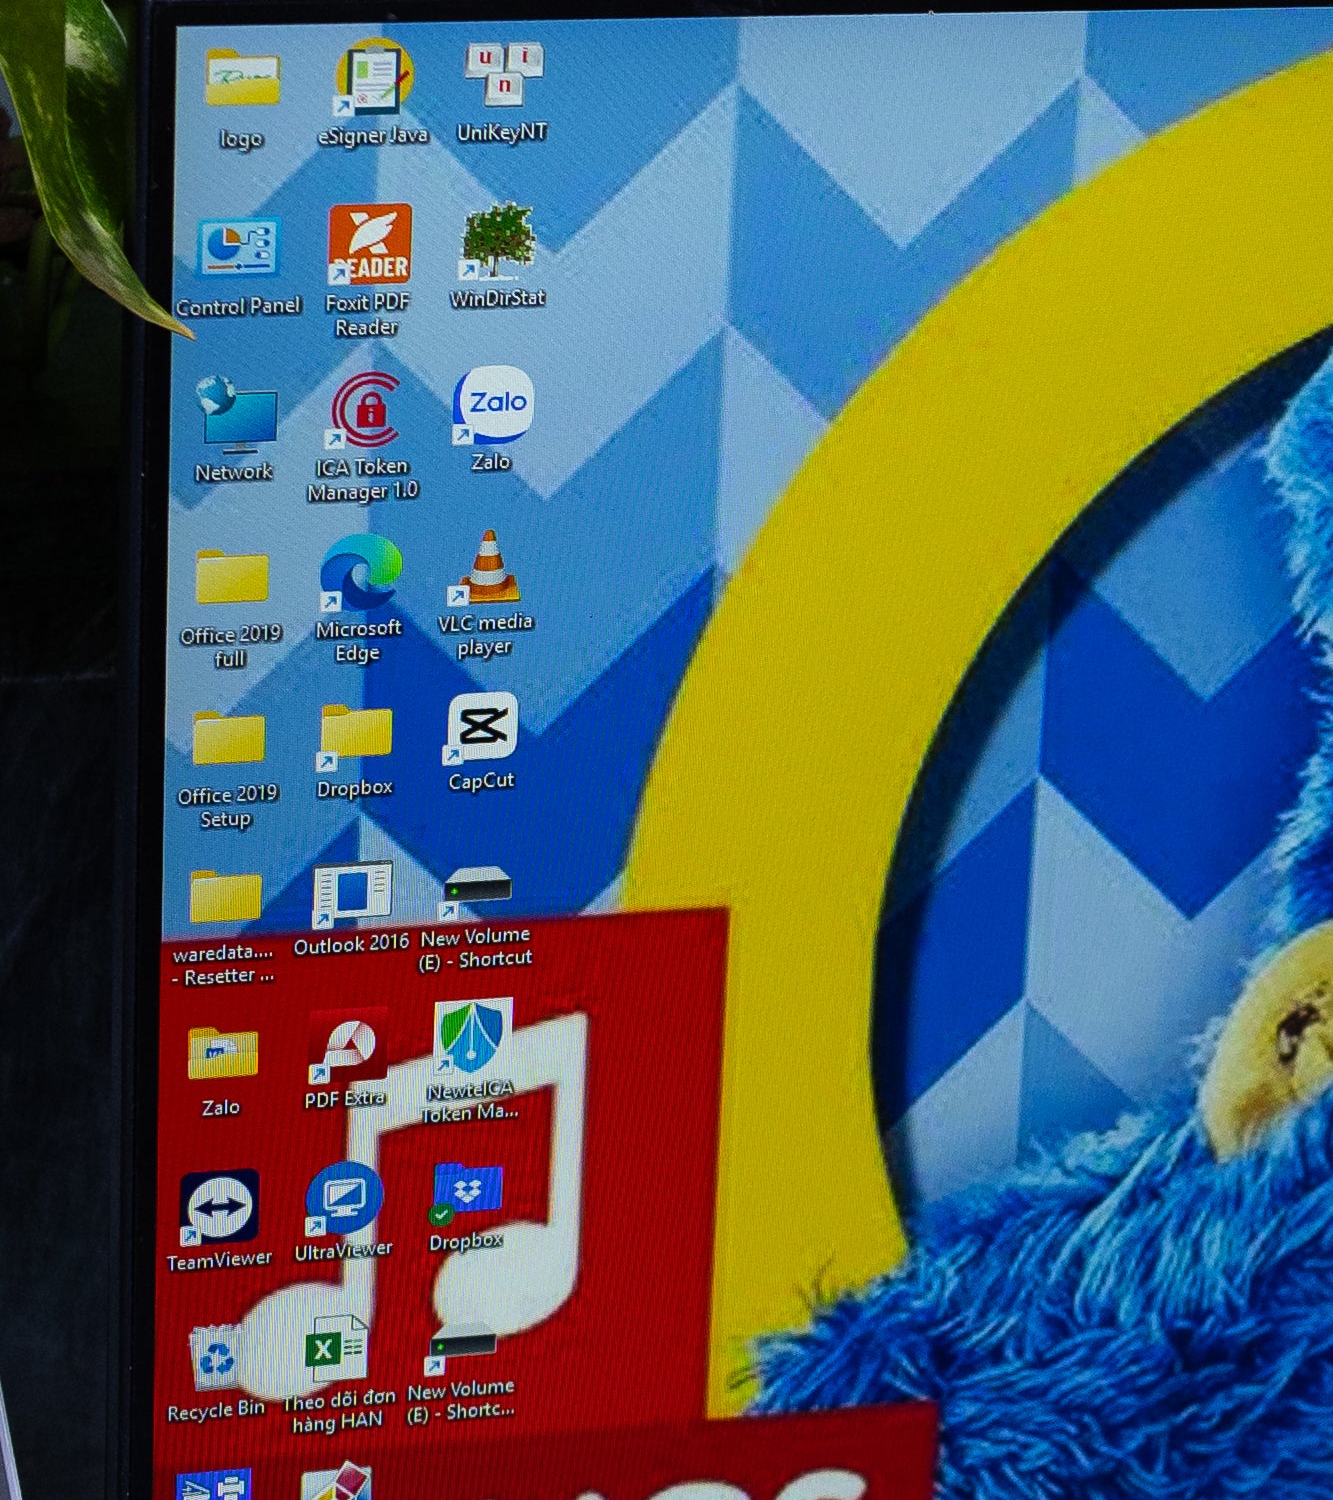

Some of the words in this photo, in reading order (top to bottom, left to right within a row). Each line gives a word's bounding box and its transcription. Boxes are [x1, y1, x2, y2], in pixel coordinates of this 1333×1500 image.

[220, 129, 264, 151] logo
[319, 127, 386, 147] eSigner
[390, 126, 429, 143] Java
[457, 123, 548, 145] UniKeyNT
[177, 299, 246, 317] Control
[251, 297, 301, 315] Panel
[326, 294, 369, 312] Foxit
[374, 293, 411, 311] PDF
[450, 290, 545, 308] WinDirStat
[336, 319, 398, 336] Reader
[470, 391, 527, 412] Zalo
[355, 458, 407, 476] Token
[471, 453, 510, 471] Zalo
[195, 463, 273, 481] Network
[308, 483, 389, 505] Manager
[394, 481, 418, 498] 1.0
[317, 621, 402, 639] Microsoft
[438, 615, 473, 632] VLC
[478, 613, 533, 630] media
[181, 627, 237, 645] Office
[243, 625, 281, 642] 2019
[336, 646, 380, 665] Edge
[458, 638, 512, 659] player
[215, 650, 245, 668] full
[318, 780, 393, 799] Dropbox
[449, 772, 515, 793] CapCut
[178, 787, 234, 805] Office
[238, 785, 278, 802] 2019
[201, 811, 251, 830] Setup
[294, 937, 365, 956] Outlook
[370, 934, 410, 952] 2016
[421, 931, 460, 947] New
[465, 928, 530, 945] Volume
[419, 955, 441, 974] (E)
[460, 950, 533, 968] Shortcut
[185, 968, 255, 986] Resetter
[202, 1100, 240, 1117] Zalo
[305, 1092, 339, 1109] PDF
[345, 1089, 385, 1106] Extra
[421, 1105, 471, 1123] Token
[295, 1242, 393, 1261] UltraViewer
[429, 1233, 504, 1252] Dropbox
[167, 1251, 272, 1272] TeamViewer
[407, 1382, 446, 1400] New
[451, 1379, 515, 1397] Volume
[168, 1404, 233, 1423] Recycle
[238, 1400, 265, 1416] Bin
[407, 1407, 429, 1425] (E)
[293, 1414, 335, 1435] hàng
[341, 1411, 382, 1428] HAN
